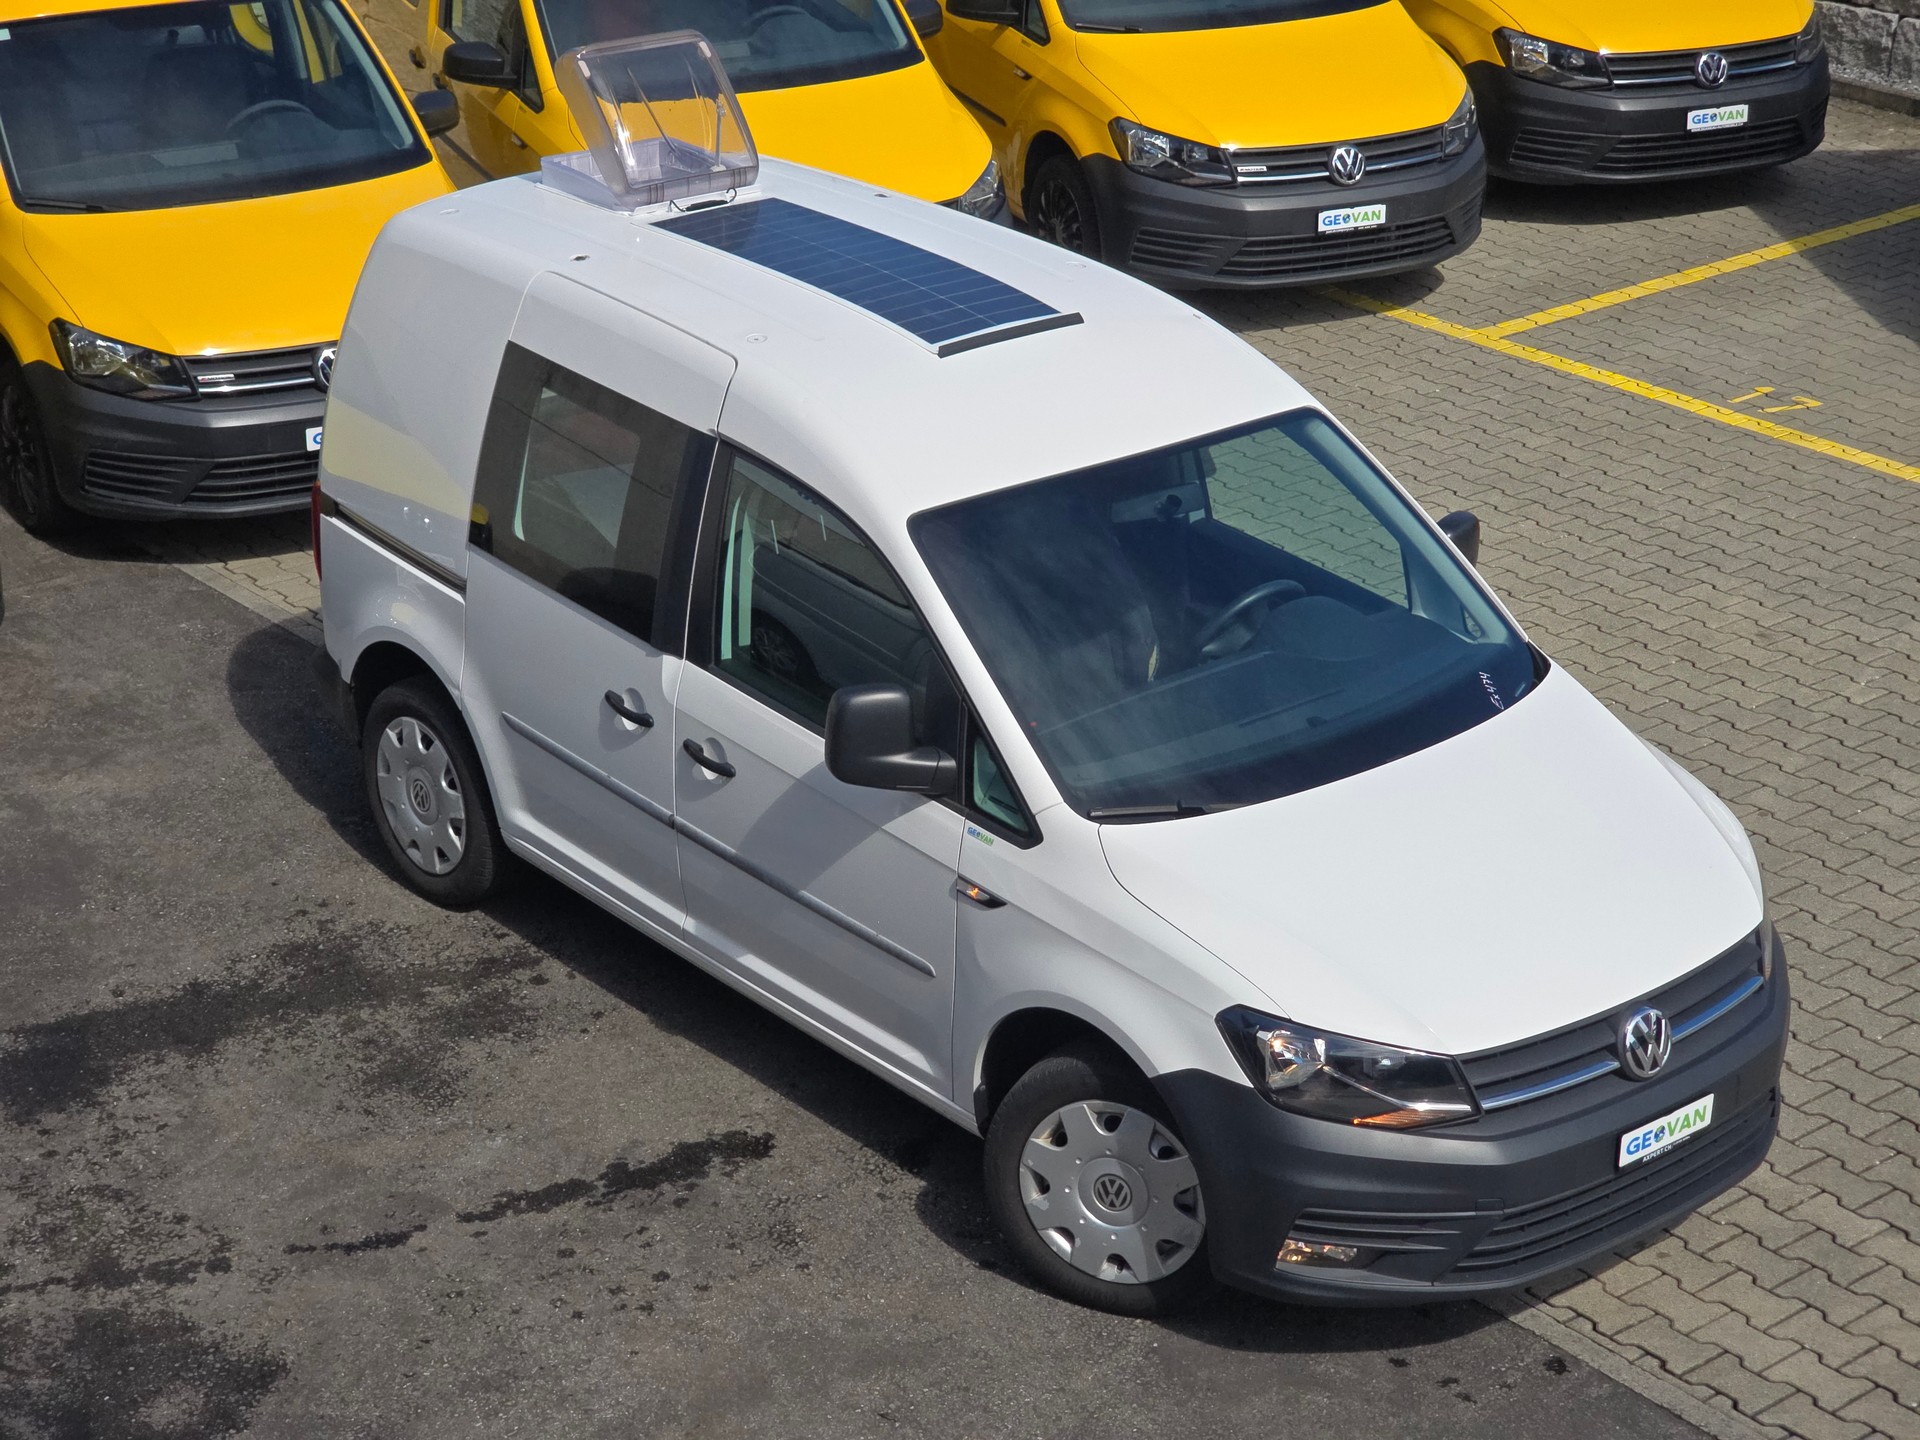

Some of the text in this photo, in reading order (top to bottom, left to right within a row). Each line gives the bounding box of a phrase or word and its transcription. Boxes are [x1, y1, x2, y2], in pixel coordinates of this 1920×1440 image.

[1692, 109, 1744, 125] GEOVAN
[1322, 210, 1382, 227] GEOVAN
[1626, 1104, 1708, 1156] GEOVAN
